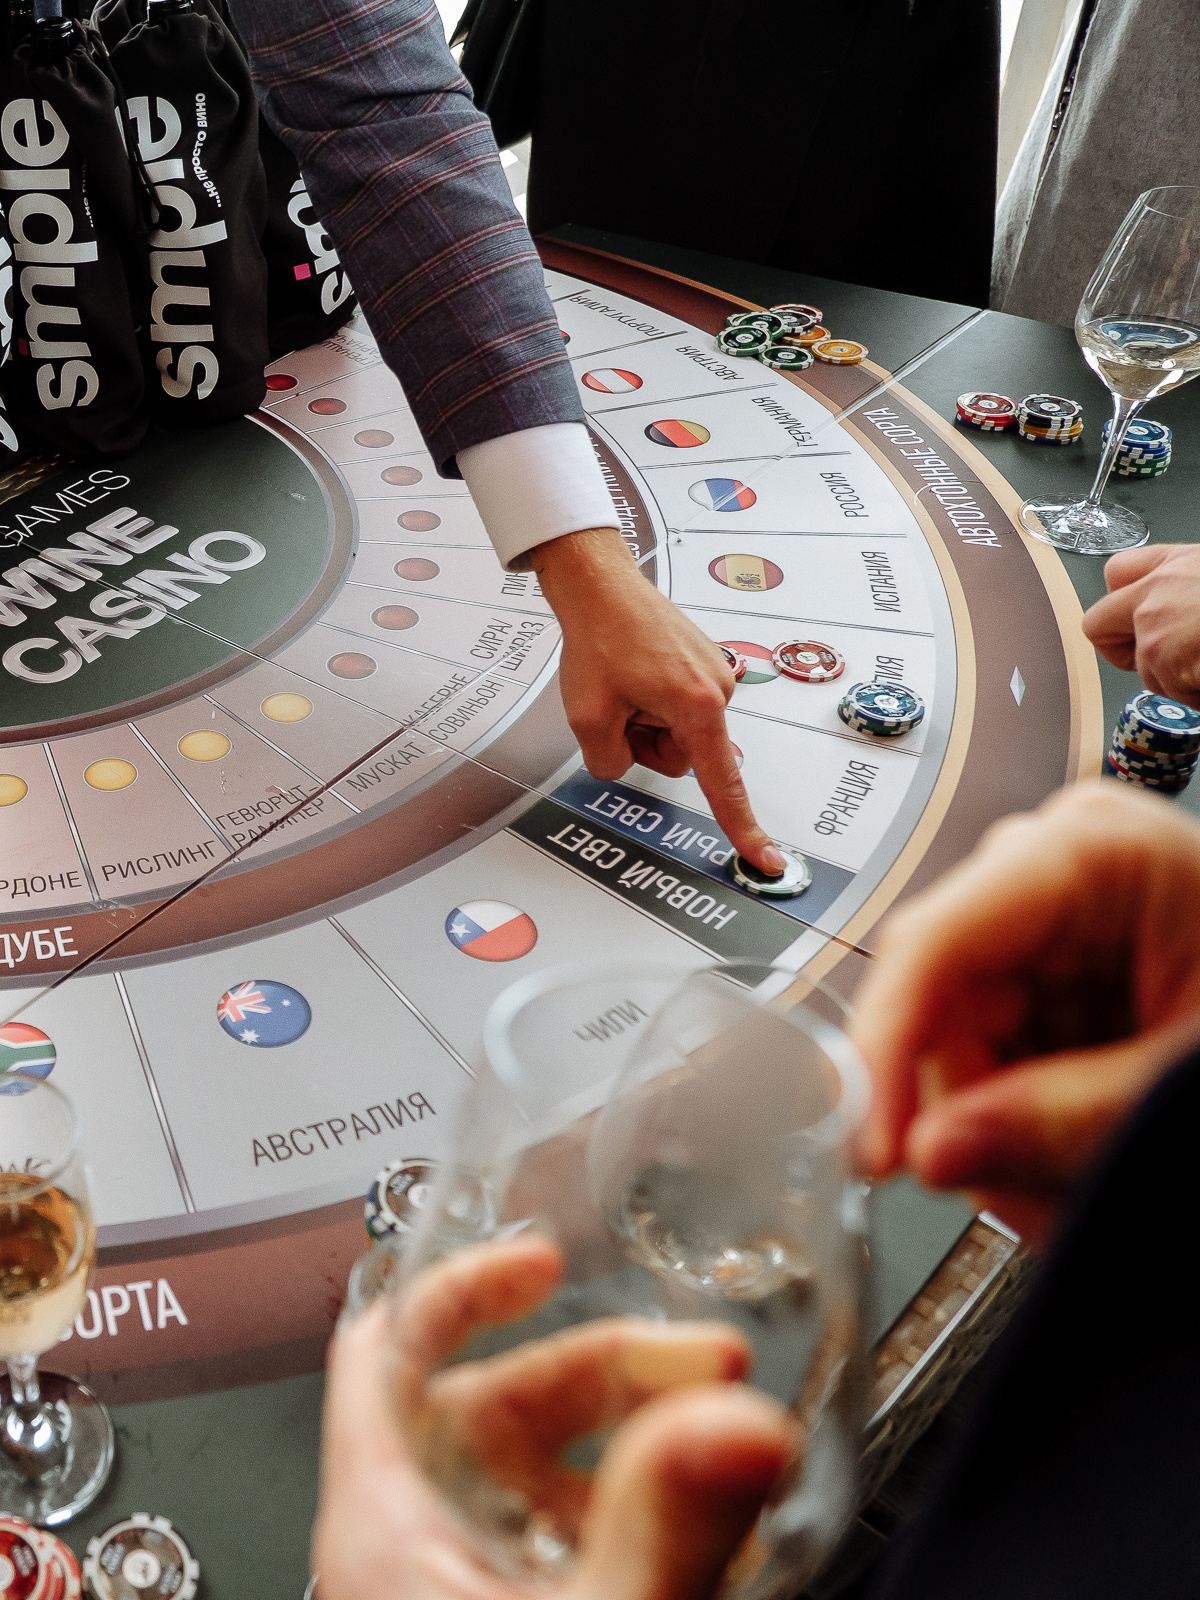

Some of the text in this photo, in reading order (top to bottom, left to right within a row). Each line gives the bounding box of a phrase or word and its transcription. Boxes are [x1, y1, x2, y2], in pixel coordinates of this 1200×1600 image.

[195, 92, 208, 128] ВИНО
[568, 294, 666, 338] ПОРТУГАЛИЯ
[674, 345, 745, 380] АВСТРИЯ
[751, 396, 819, 448] ГЕРМАНИЯ
[818, 471, 870, 519] РОССИЯ
[861, 407, 1002, 548] АВТОХТОННЫЕ СОРТА
[1, 530, 267, 684] CASINO
[860, 551, 902, 613] ИСПАНИЯ
[469, 617, 513, 660] СИРА/
[428, 679, 505, 741] СОВИНЬОН
[345, 740, 428, 794] МУСКАТ
[814, 759, 880, 837] ФРАНЦИЯ
[584, 791, 735, 867] РЫЙ СВЕТ
[101, 839, 218, 883] РИСЛИНГ
[546, 822, 739, 931] НОВЫЙ СВЕТ
[573, 998, 649, 1043] ЧИЛИ
[251, 1090, 438, 1167] АВСТРАЛИЯ
[62, 1277, 189, 1342] ОРТА
